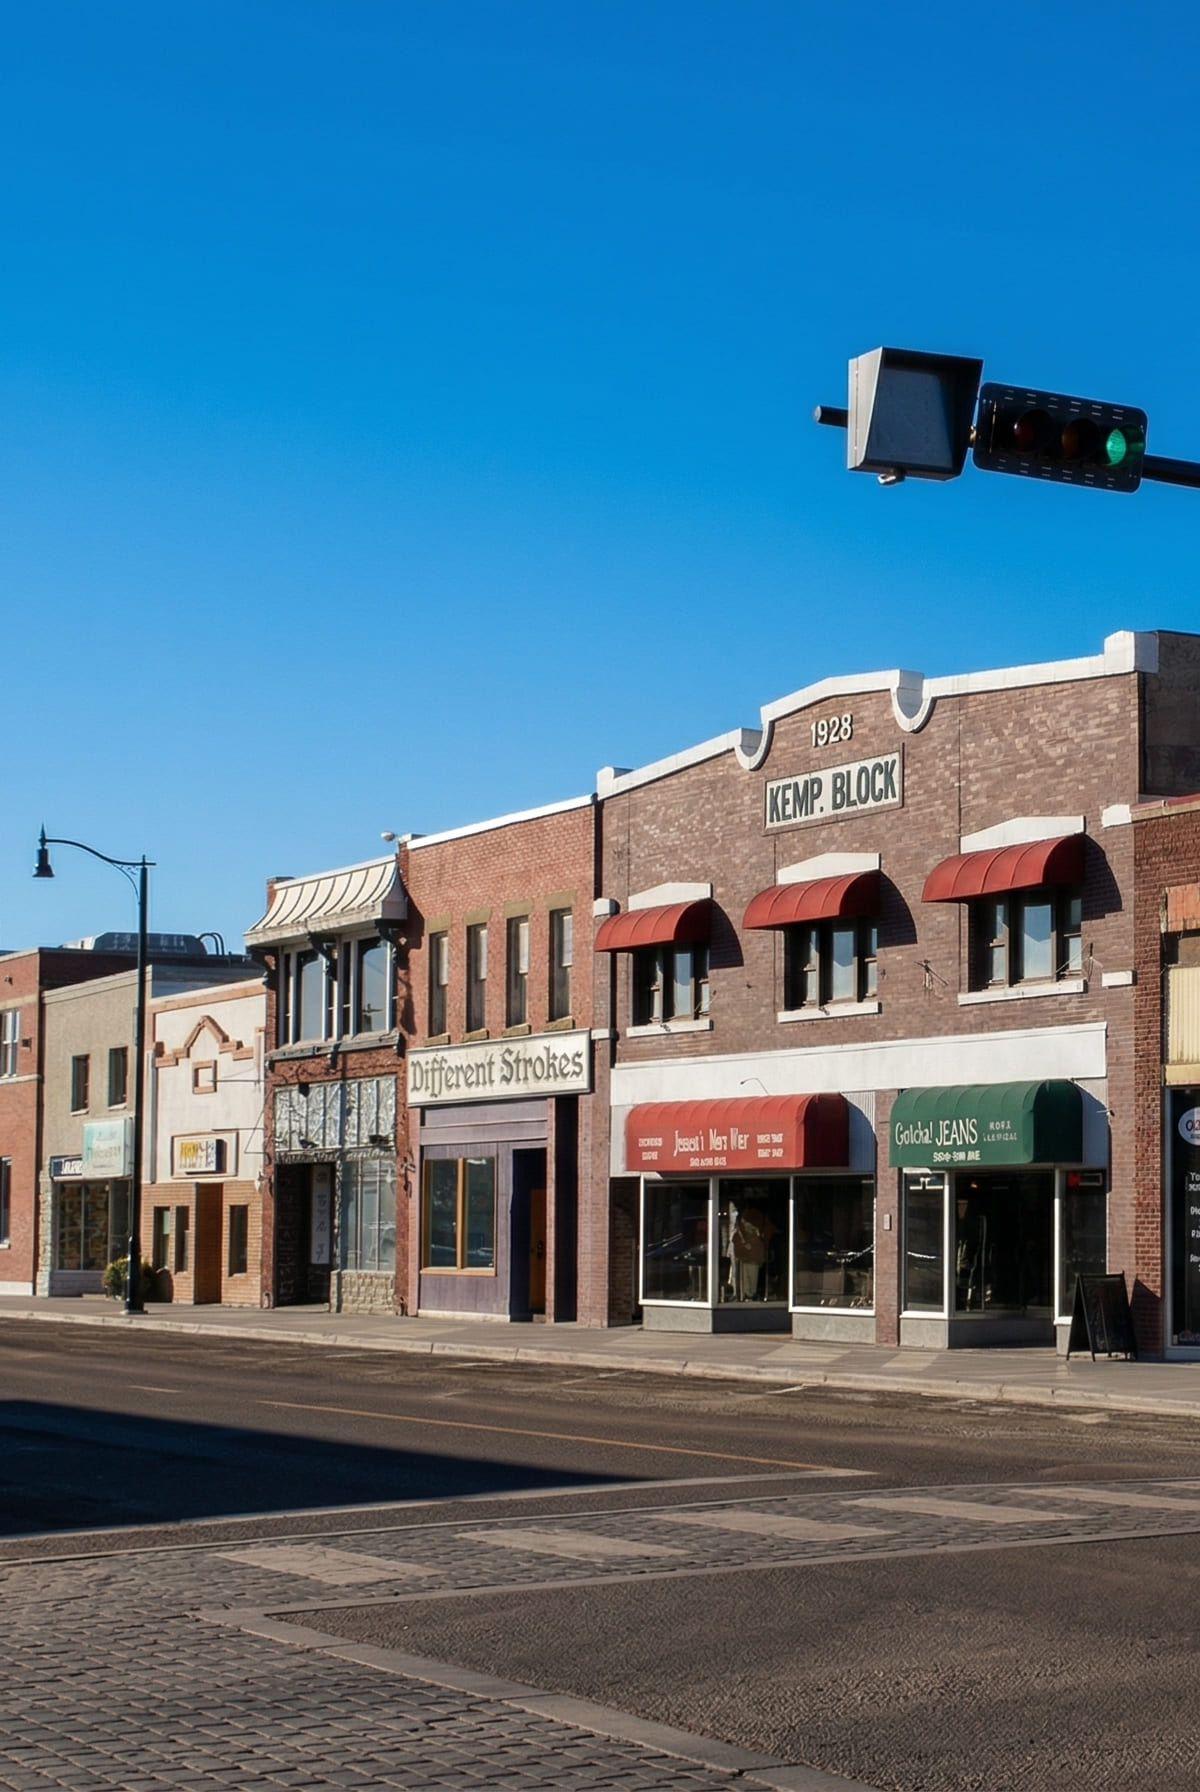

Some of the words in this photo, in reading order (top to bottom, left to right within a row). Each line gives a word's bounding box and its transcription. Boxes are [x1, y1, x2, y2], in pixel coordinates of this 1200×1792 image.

[810, 714, 853, 747] 1928
[769, 777, 824, 823] KEMP.
[832, 759, 897, 811] BLOCK
[410, 1053, 495, 1098] Different
[500, 1045, 584, 1085] Strokes
[935, 1118, 978, 1147] JEANS
